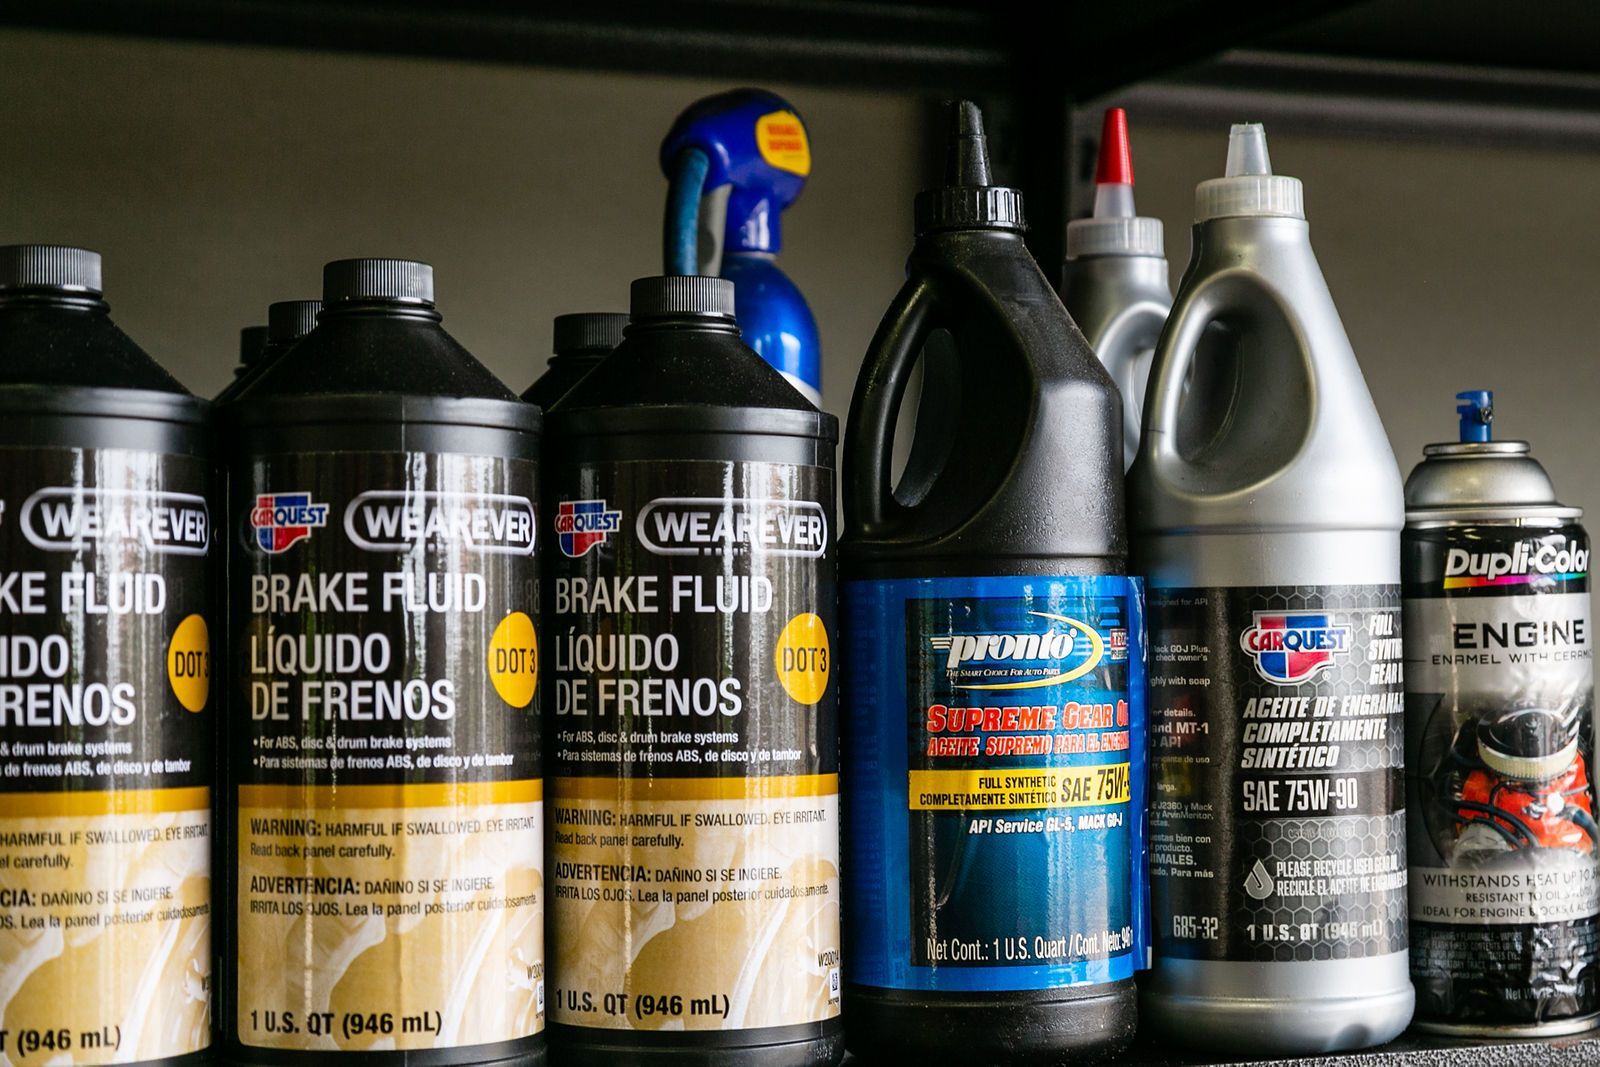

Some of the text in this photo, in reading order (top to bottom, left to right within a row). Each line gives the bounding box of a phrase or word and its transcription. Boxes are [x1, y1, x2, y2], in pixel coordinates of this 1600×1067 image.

[41, 503, 207, 543] WEAREVER
[554, 511, 821, 545] CARQUEST WEAREVER
[252, 573, 369, 613] BRAKE
[383, 573, 486, 613] FLUID
[556, 576, 658, 614] BRAKE
[672, 575, 773, 613] FLUID
[1369, 614, 1393, 636] FULL
[1453, 619, 1585, 649] ENGINE
[251, 626, 391, 676] LÍQUIDO
[555, 626, 680, 674] LÍQUIDO
[946, 629, 1074, 668] pronto
[1248, 629, 1345, 652] CARQUEST
[496, 648, 536, 674] DOT 3
[783, 647, 827, 672] DOT 3
[1432, 652, 1549, 665] ENAMEL WITH
[1168, 676, 1210, 687] with soap
[252, 679, 455, 721] DE FRENOS
[556, 677, 742, 717] DE FRENOS
[1243, 696, 1337, 719] ACEITE DE
[927, 701, 1113, 732] SUPREME GEAR
[1164, 708, 1196, 717] details.
[562, 730, 739, 746] For ABS, disc & drum brake systems
[1243, 718, 1387, 743] COMPLETAMENTE
[927, 733, 1100, 756] ACEITE SUPREMO PARA EL
[1160, 736, 1181, 748] API
[562, 748, 801, 764] Para sistemas de frenos ABS, de disco y de tambor
[1241, 743, 1340, 768] SINTÉTICO
[4, 758, 191, 778] de frenos ABS, de disco y de tambor
[979, 775, 1057, 789] FULL SYNTHETIC
[1061, 777, 1092, 802] SAE
[920, 789, 1057, 806] COMPLETAMENTE SINTÉTICO
[1243, 778, 1358, 812] SAE 75W-90
[555, 807, 826, 827] WARNING: HARMFUL IF SWALLOWED. EYE IRRITANT.
[969, 820, 991, 834] API
[995, 818, 1043, 834] Service
[1046, 817, 1075, 833] GL-5,
[1078, 814, 1106, 831] MACK
[555, 831, 685, 849] Read back panel carefully.
[1155, 843, 1192, 852] producto.
[1176, 834, 1193, 842] bien
[14, 854, 73, 870] carefully.
[555, 862, 783, 883] ADVERTENCIA: DAÑINO SI SE INGIERE.
[1171, 868, 1214, 878] Para más
[1276, 860, 1312, 877] PLEASE
[1313, 858, 1353, 876] RECYCLE
[1277, 879, 1314, 896] RECICLE
[1317, 879, 1327, 895] EL
[1330, 877, 1358, 895] ACEITE
[1423, 873, 1520, 888] WITHSTANDS
[1527, 872, 1558, 886] HEAT
[1466, 893, 1523, 903] RESISTANT
[21, 911, 153, 930] Lea la panel posterior
[1423, 906, 1450, 917] IDEAL
[1454, 907, 1476, 918] FOR
[1480, 906, 1525, 918] ENGINE
[1173, 915, 1218, 940] 685-32
[1247, 924, 1255, 941] 1
[1263, 924, 1295, 941] U.S.
[1300, 923, 1319, 941] QT
[1324, 921, 1359, 940] (946
[927, 930, 1121, 961] Net Cont.: 1 U.S. Quart / Cont. Neto:
[556, 989, 730, 1019] 1 U.S. QT (946 mL)
[251, 1011, 442, 1039] 1 U.S. QT (946 mL)
[17, 1027, 121, 1056] (946 mL)
